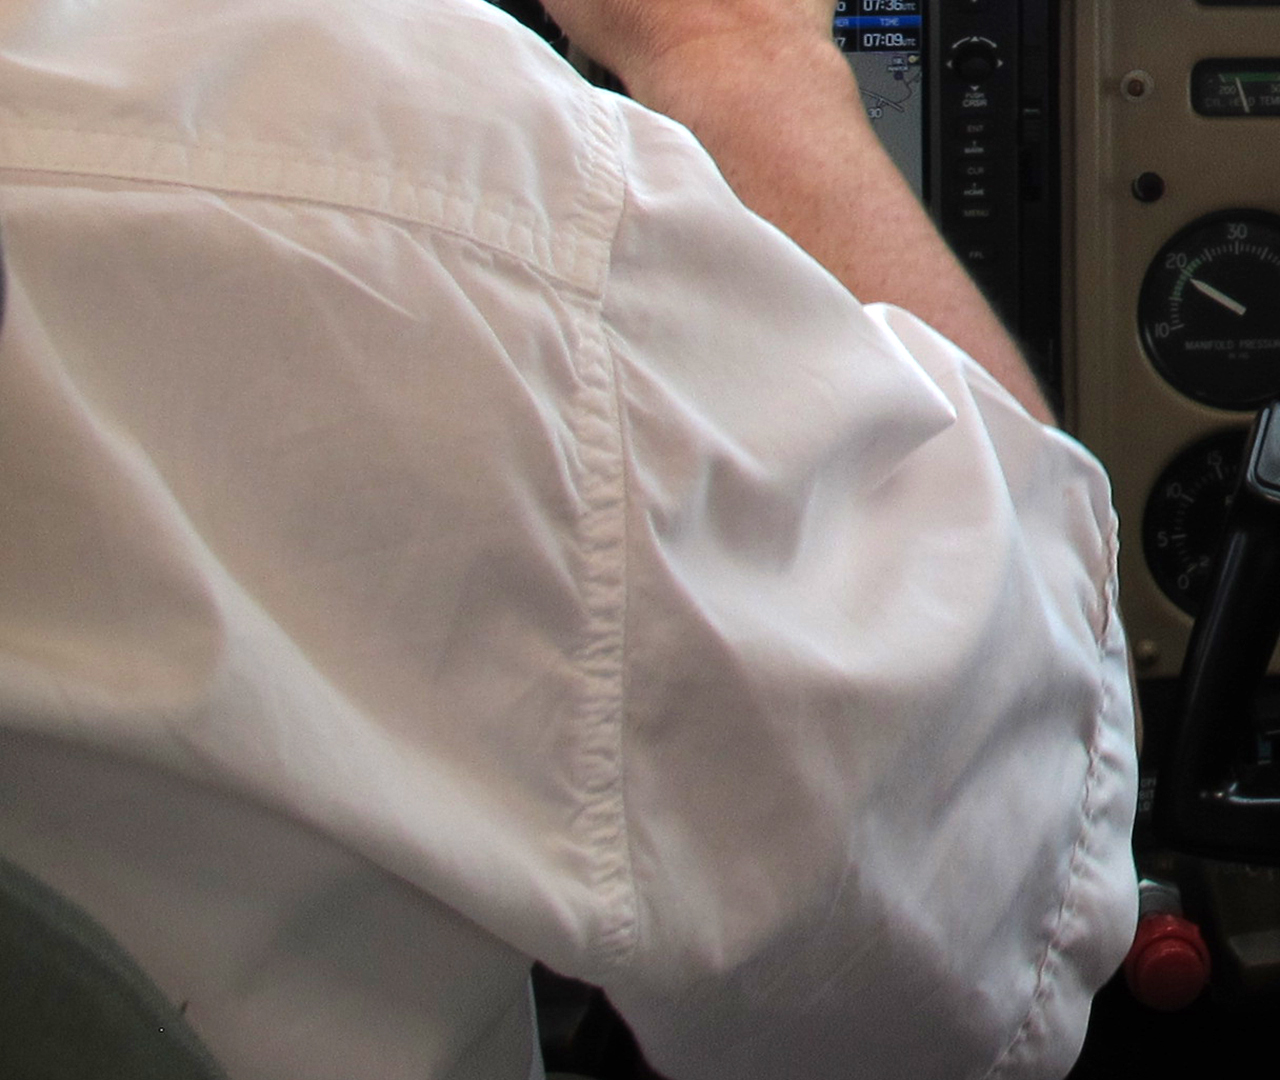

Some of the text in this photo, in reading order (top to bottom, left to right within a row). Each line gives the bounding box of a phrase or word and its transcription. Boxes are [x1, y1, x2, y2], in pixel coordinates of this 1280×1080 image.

[863, 34, 903, 47] 07:09
[1227, 223, 1248, 240] 30
[1165, 252, 1188, 269] 20
[1154, 321, 1171, 338] 10
[1184, 340, 1235, 351] MANIFOLD
[1158, 530, 1169, 548] 5
[1178, 573, 1190, 590] 0
